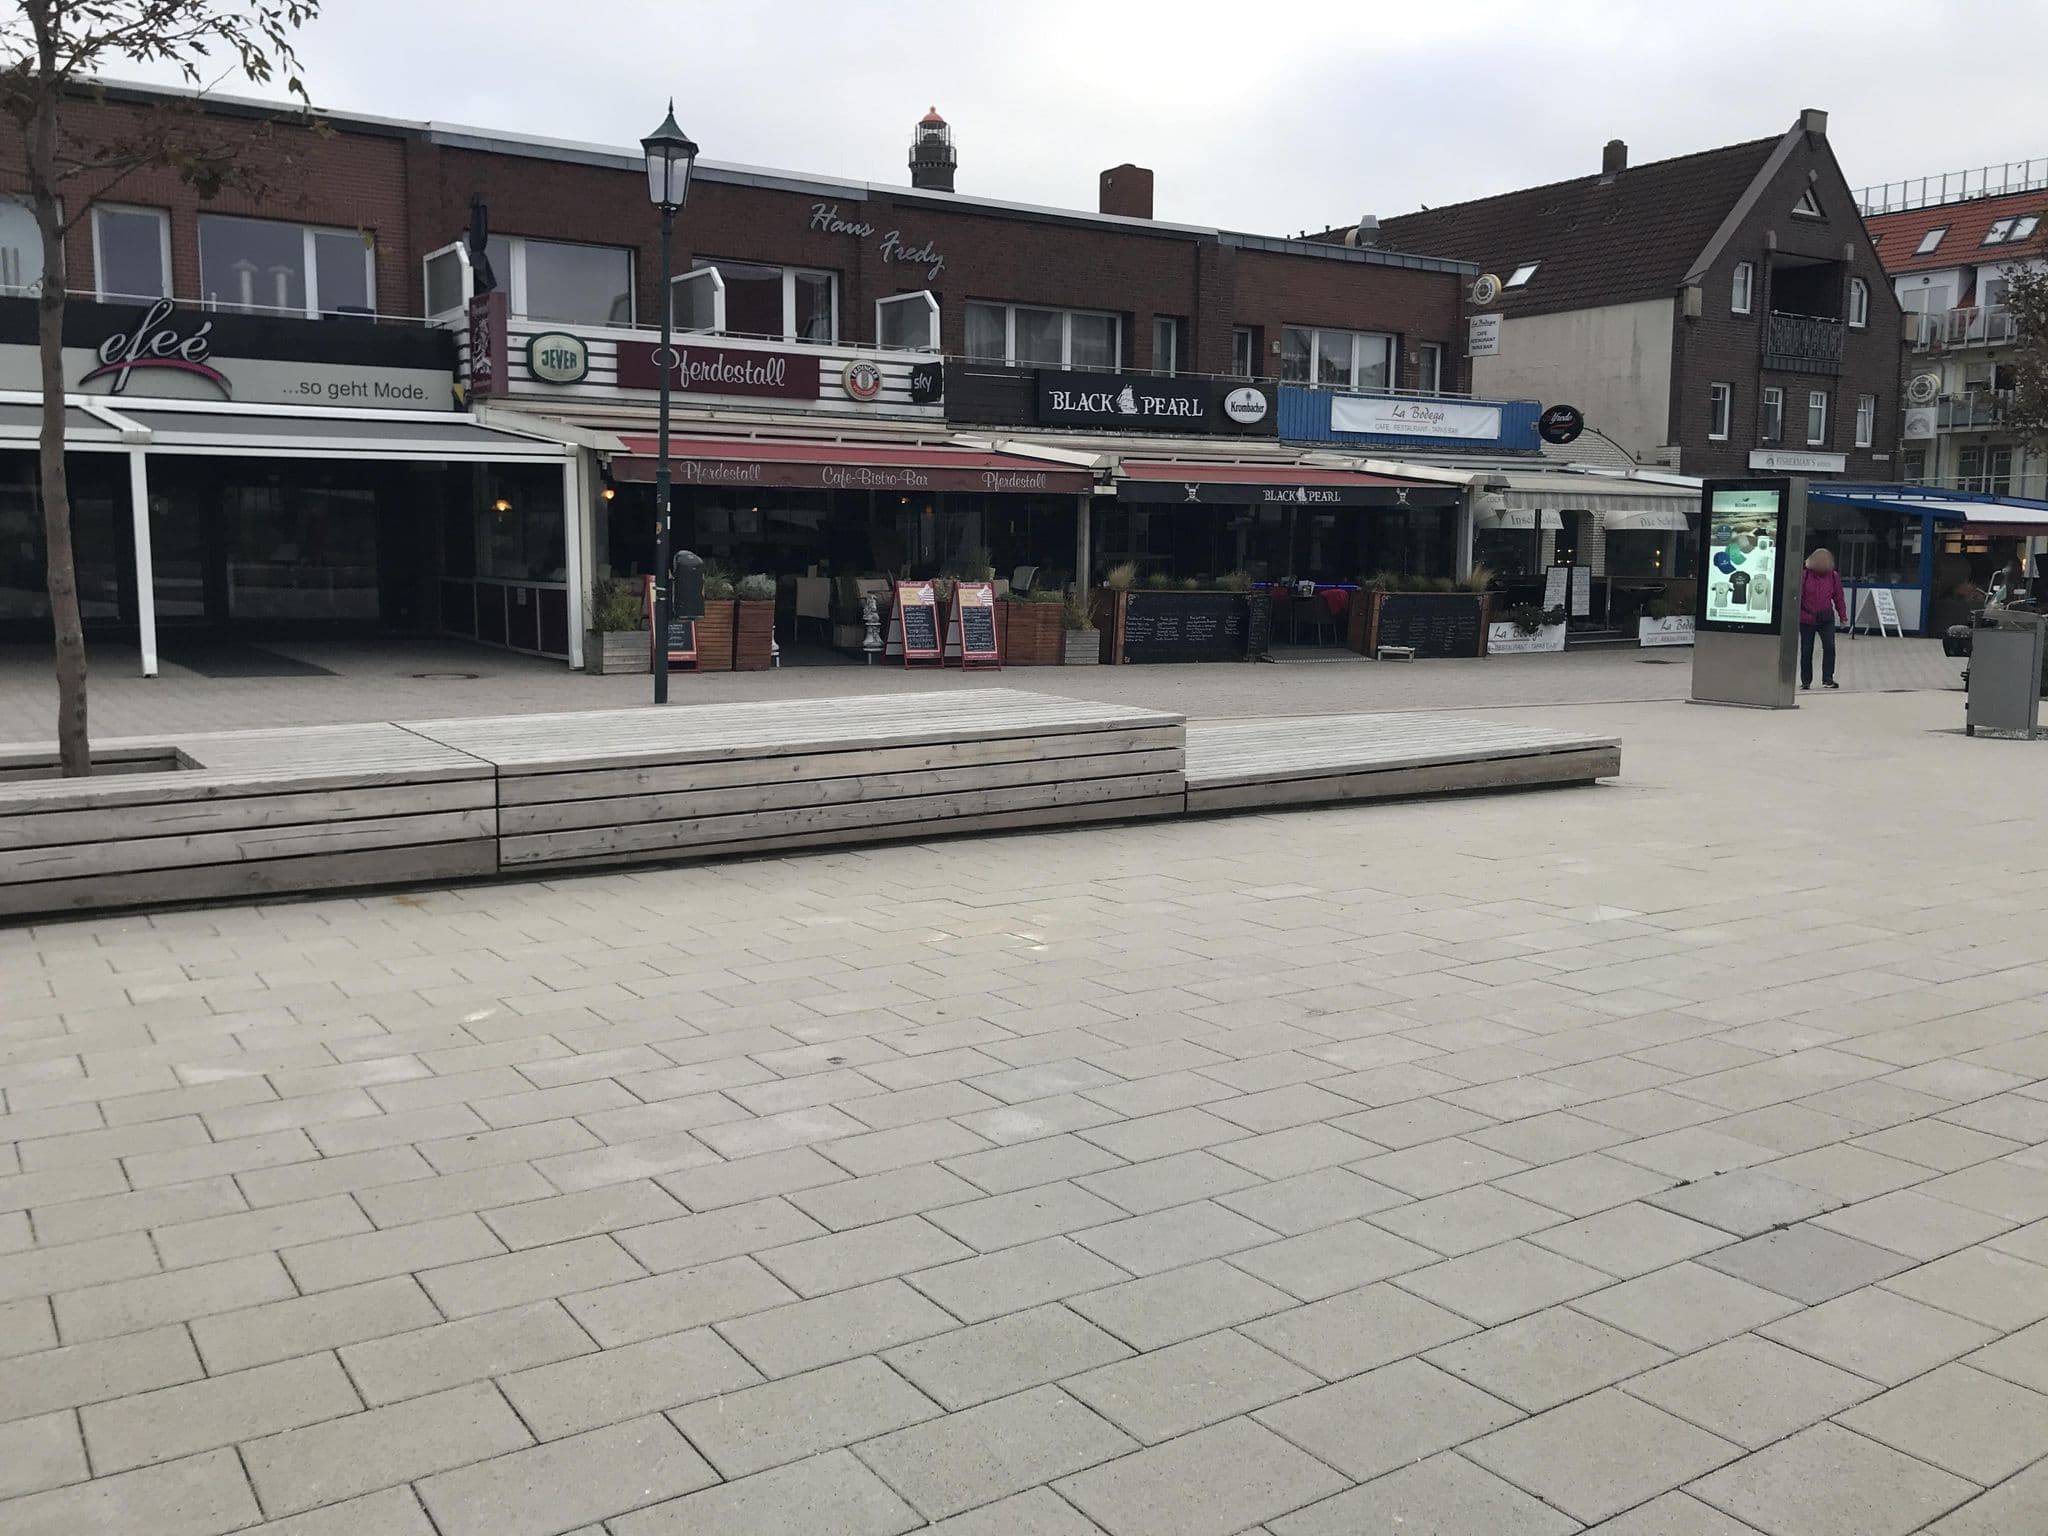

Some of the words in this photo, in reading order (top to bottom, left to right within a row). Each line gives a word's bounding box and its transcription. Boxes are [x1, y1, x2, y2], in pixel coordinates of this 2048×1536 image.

[879, 230, 946, 281] Fredy
[541, 349, 578, 370] JEVER
[327, 380, 369, 400] geht
[373, 382, 430, 401] Mode.
[913, 372, 933, 393] sky
[1048, 390, 1114, 413] BLACK
[1140, 396, 1203, 417] PEARL
[1230, 400, 1265, 415] Krombacher
[1391, 404, 1406, 419] La
[1410, 406, 1445, 425] Bodega
[680, 460, 761, 484] Pferdestall
[981, 471, 1047, 492] Pferdestall
[1262, 489, 1297, 502] BLACK
[1307, 490, 1341, 503] PEARL
[1494, 626, 1507, 640] La
